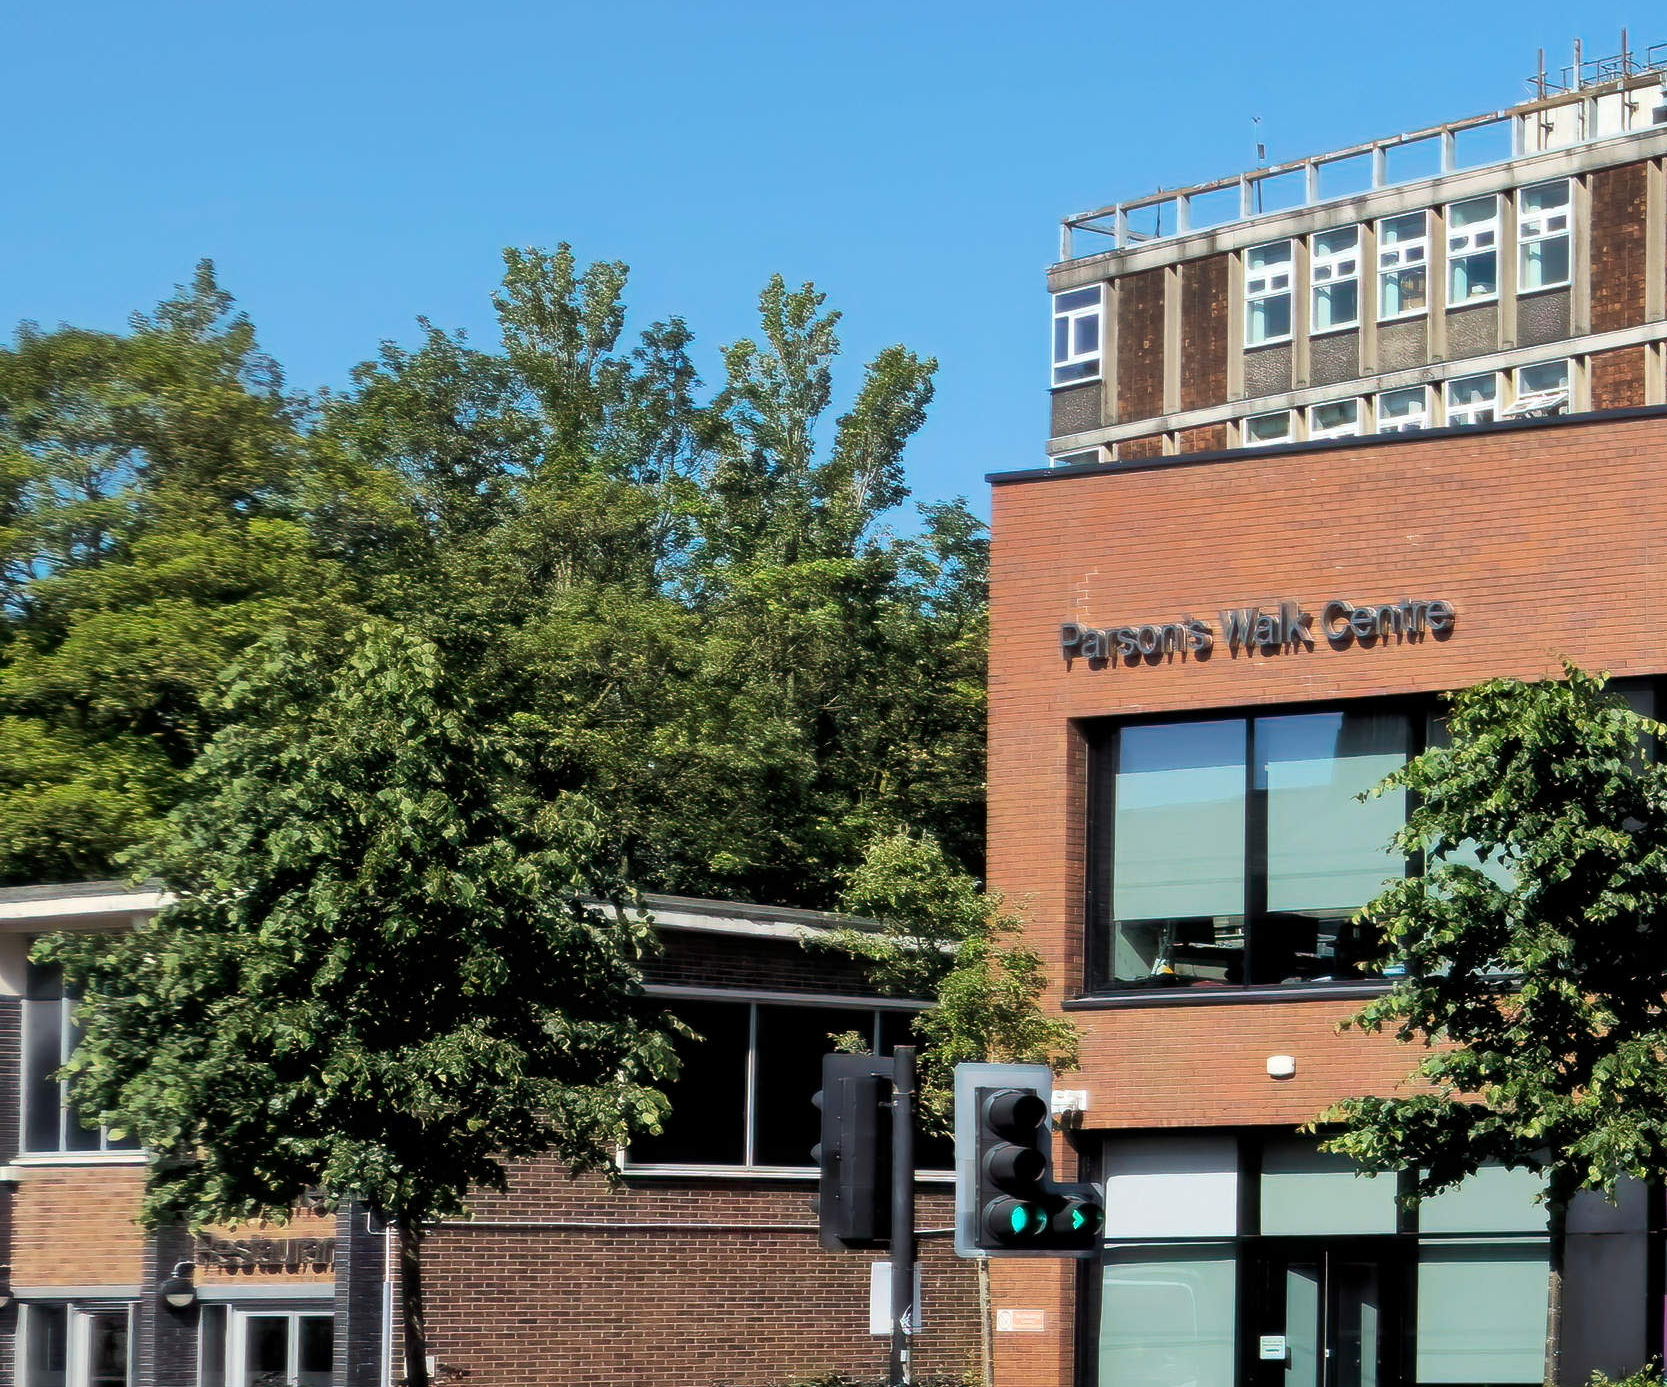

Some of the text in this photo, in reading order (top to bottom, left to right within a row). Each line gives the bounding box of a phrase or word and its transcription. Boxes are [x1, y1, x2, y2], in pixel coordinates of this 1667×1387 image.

[1061, 598, 1455, 661] Parson's Walk Centre
